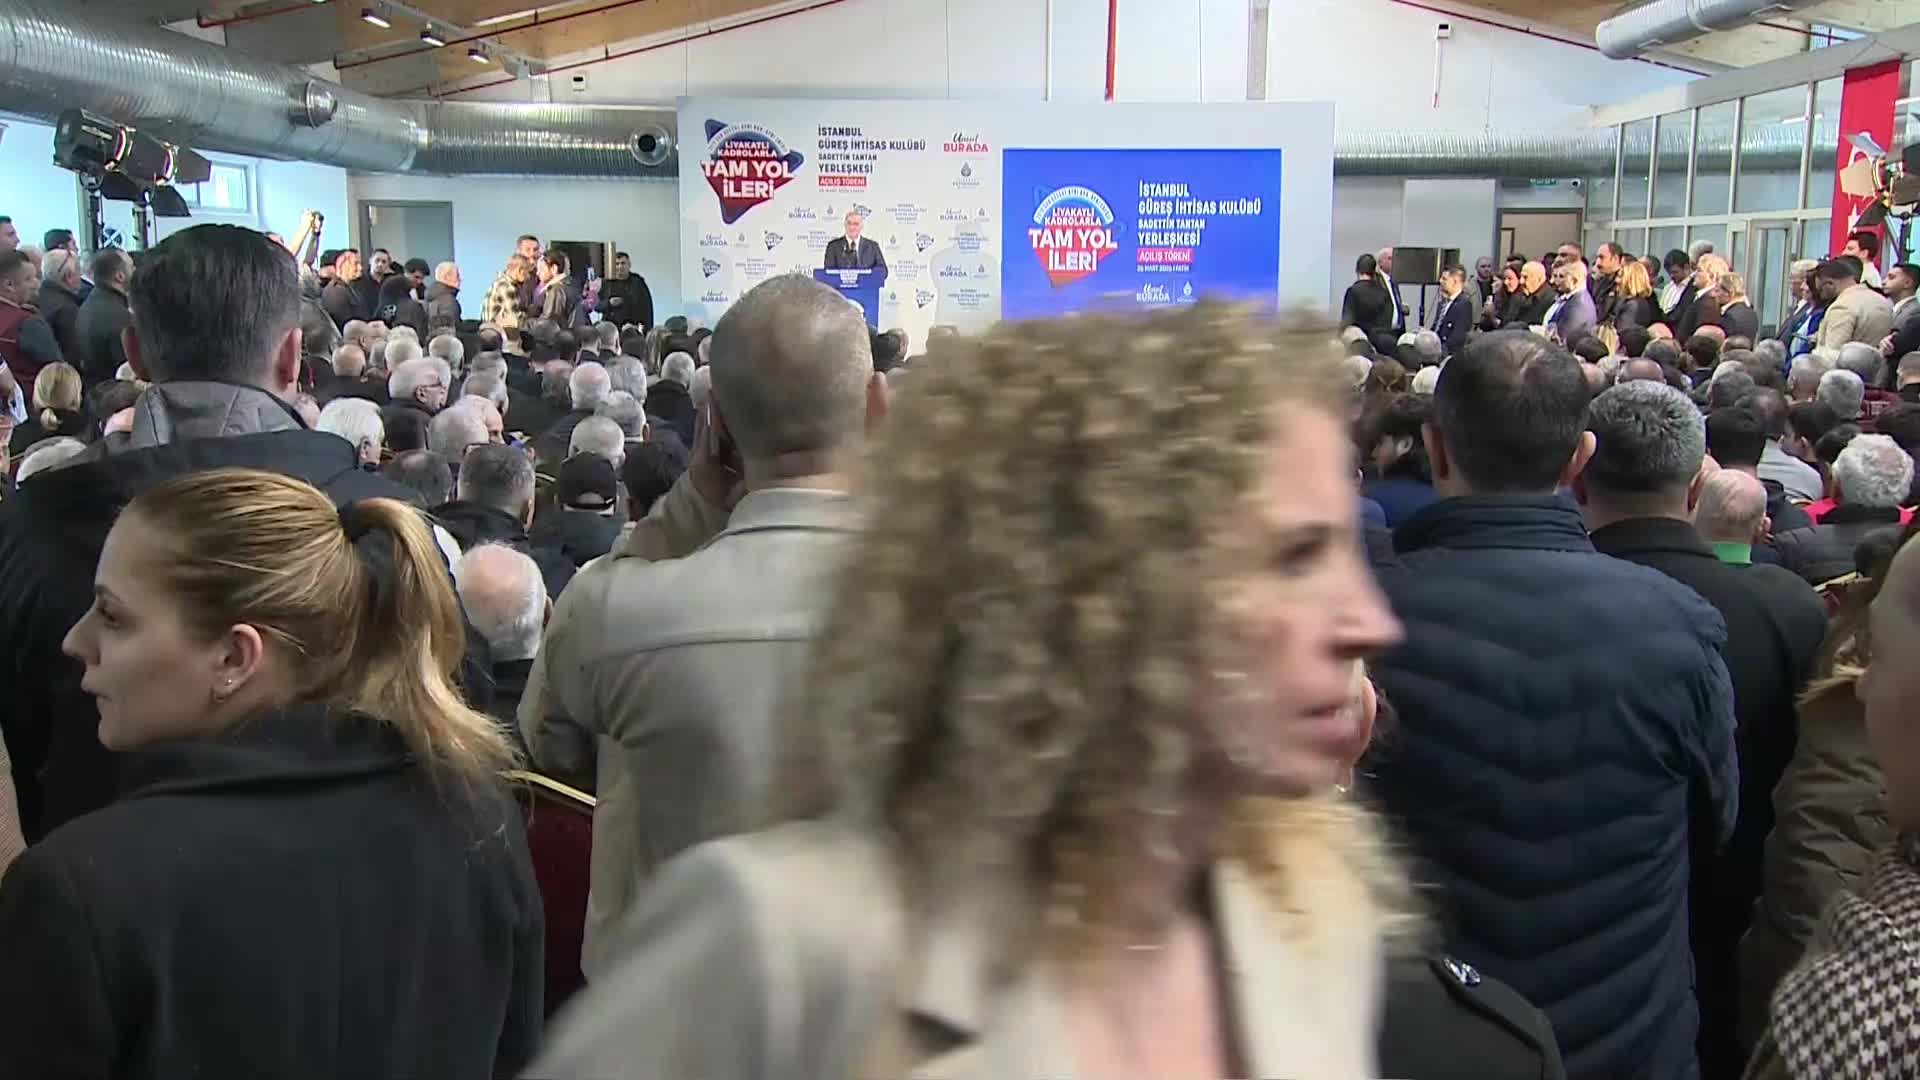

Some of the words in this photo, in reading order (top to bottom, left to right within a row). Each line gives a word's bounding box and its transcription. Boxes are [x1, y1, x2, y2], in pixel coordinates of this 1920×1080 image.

[818, 124, 862, 136] İSTANBUL
[818, 138, 848, 151] GÜREŞ
[851, 137, 887, 150] İHTİSAS
[889, 138, 926, 150] KULÜBÜ
[943, 143, 988, 152] BURADA
[701, 160, 748, 178] TAM
[752, 160, 794, 179] YOL
[818, 161, 873, 174] YERLEŞKESİ
[723, 178, 774, 198] İLERİ
[1139, 179, 1190, 197] İSTANBUL
[1138, 198, 1172, 217] GÜREŞ
[1175, 197, 1217, 215] İHTİSAS
[1219, 198, 1262, 215] KULÜBÜ
[1045, 217, 1101, 226] KADROLARLA
[1028, 229, 1073, 248] TAM
[1077, 229, 1118, 248] YOL
[1138, 230, 1201, 248] YERLEŞKESİ
[1049, 249, 1097, 271] İLERİ
